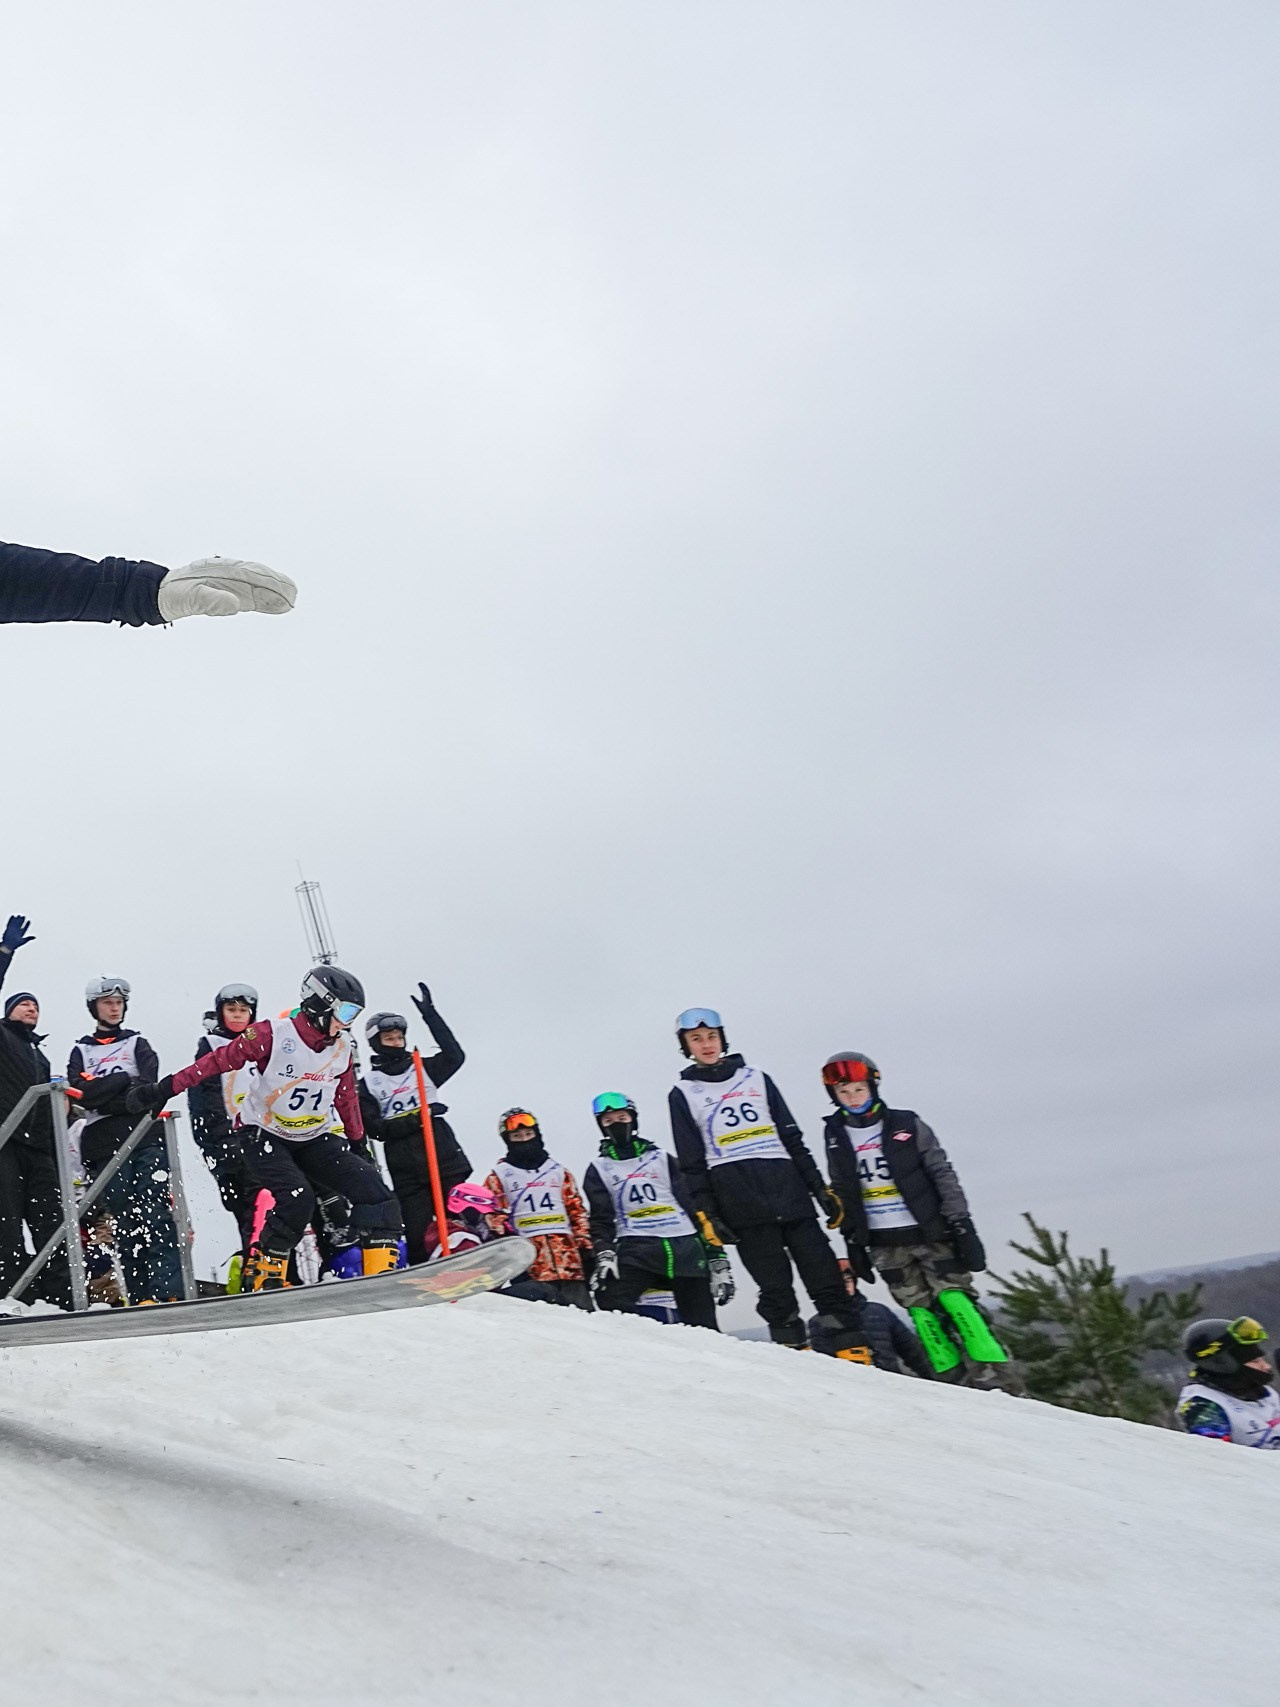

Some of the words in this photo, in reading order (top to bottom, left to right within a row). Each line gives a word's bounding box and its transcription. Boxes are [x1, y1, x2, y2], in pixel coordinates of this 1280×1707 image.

[288, 1087, 323, 1111] 51
[721, 1102, 758, 1127] 36
[856, 1157, 893, 1182] 45
[523, 1192, 555, 1212] 14
[629, 1183, 657, 1204] 40
